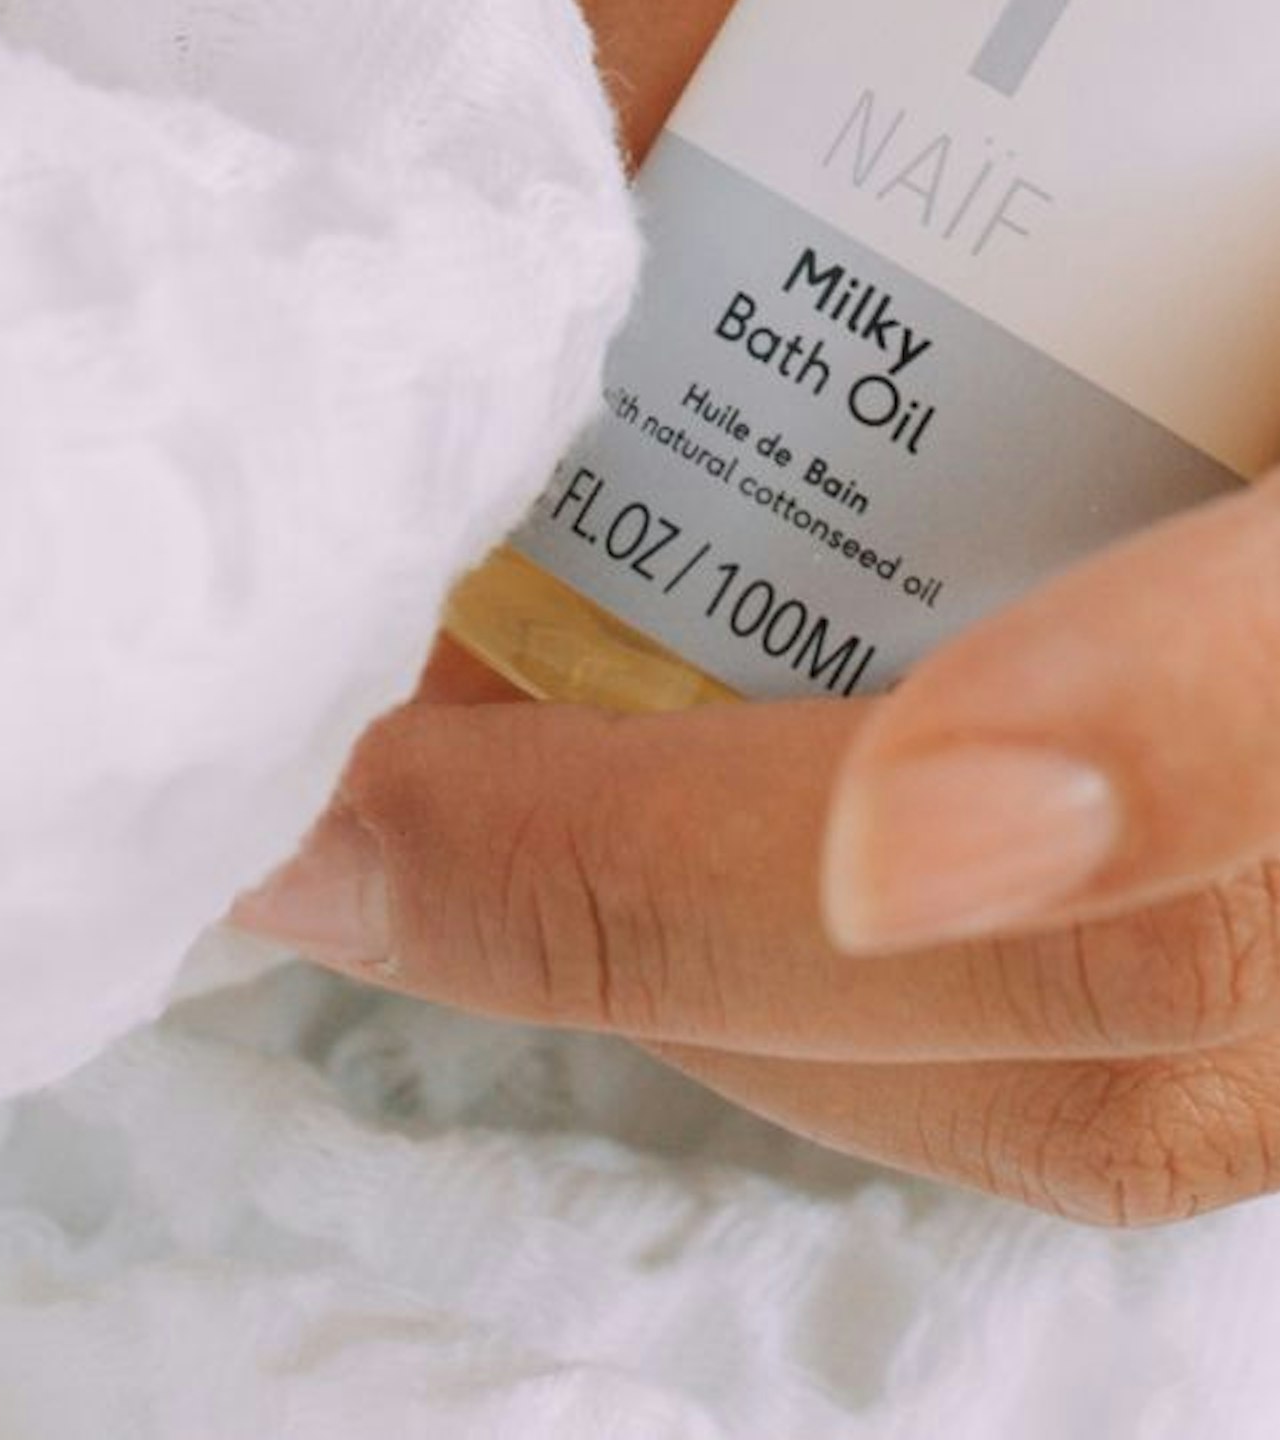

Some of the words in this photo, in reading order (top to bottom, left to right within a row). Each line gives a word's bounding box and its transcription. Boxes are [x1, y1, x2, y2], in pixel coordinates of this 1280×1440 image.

[821, 88, 1055, 258] NAÏF
[714, 290, 831, 396] Bath
[847, 374, 935, 456] Oil
[781, 246, 933, 377] Milky
[640, 416, 740, 484] natural
[738, 476, 903, 581] cottonseed
[902, 574, 945, 609] oil
[681, 383, 751, 442] Huile
[756, 433, 793, 468] de
[803, 456, 870, 514] Bain
